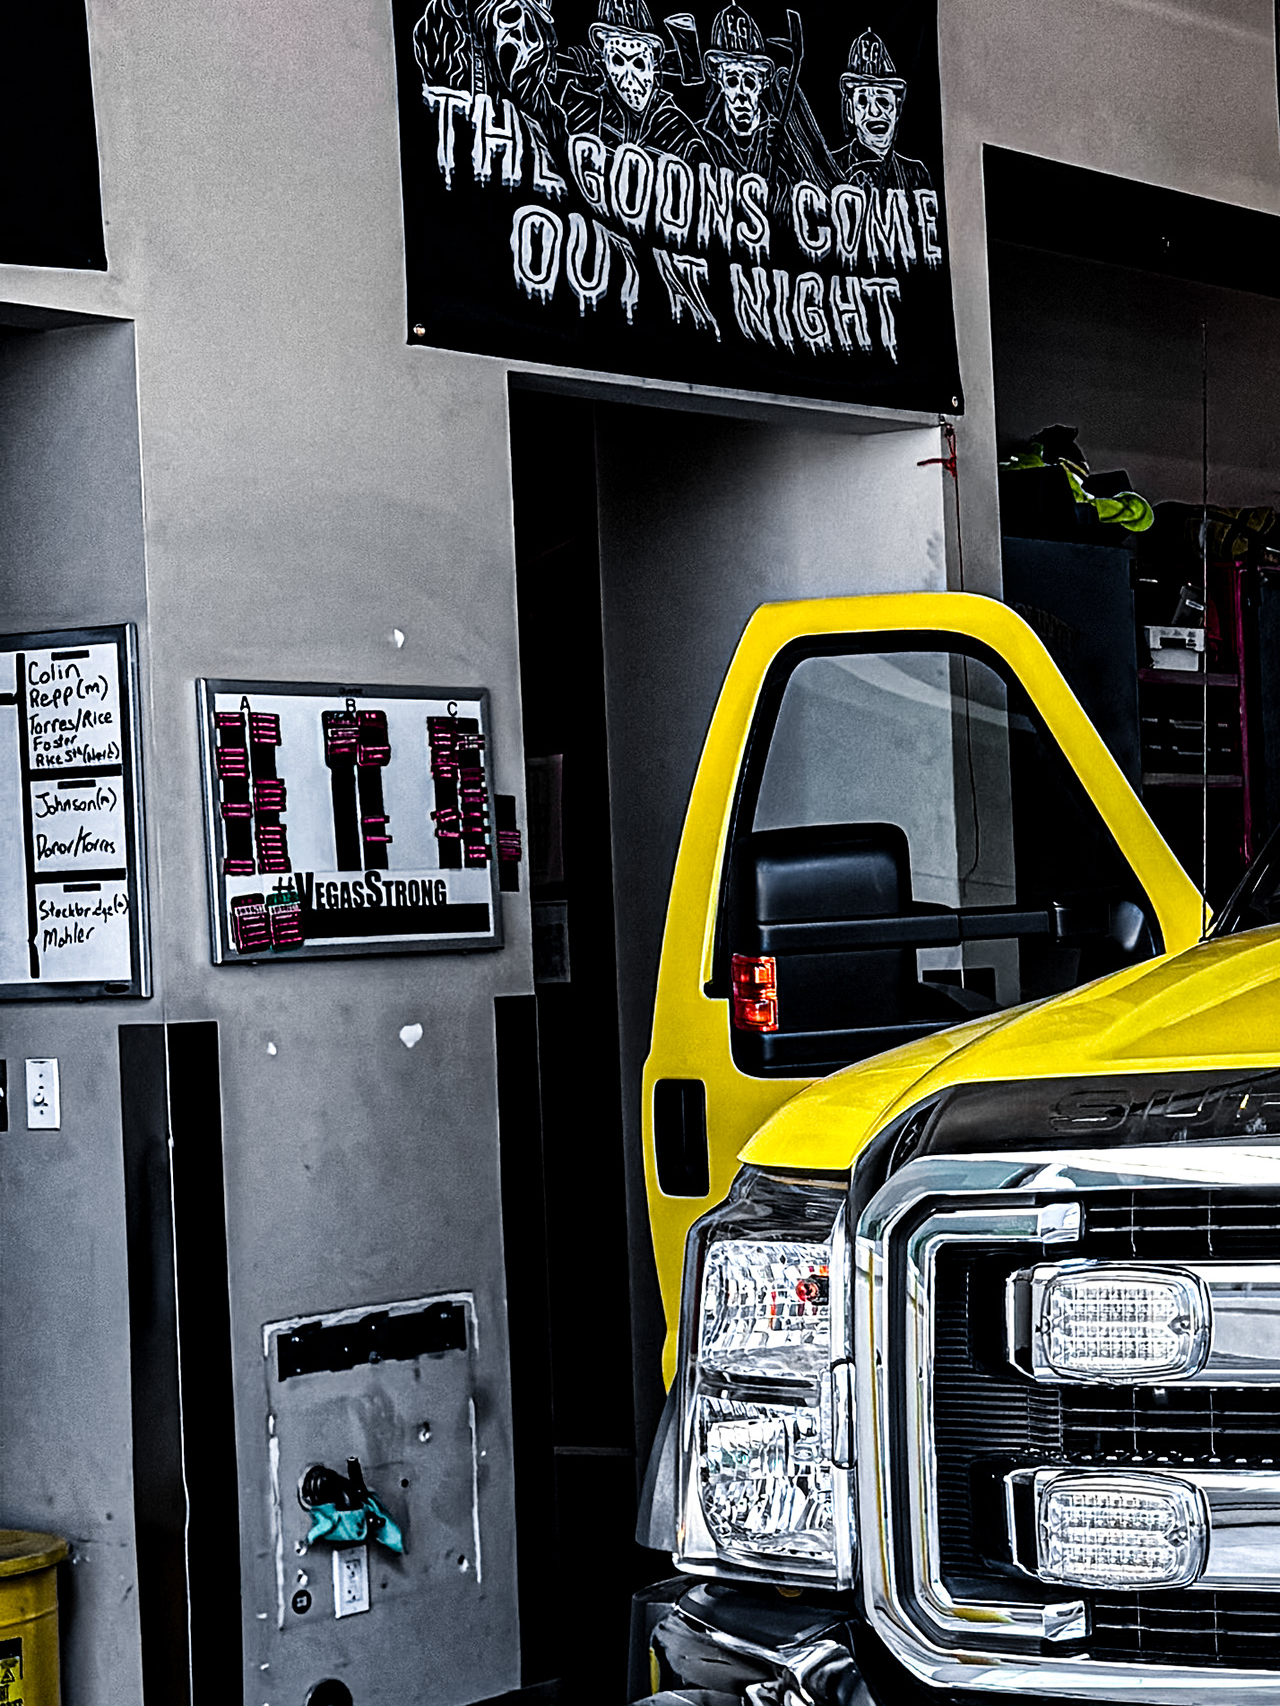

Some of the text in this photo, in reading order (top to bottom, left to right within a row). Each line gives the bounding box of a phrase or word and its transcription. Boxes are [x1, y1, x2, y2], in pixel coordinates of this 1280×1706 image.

[567, 132, 770, 263] GOONS
[791, 179, 942, 271] COME
[730, 262, 903, 363] NIGHT
[28, 661, 80, 686] Colin
[240, 695, 251, 712] A
[345, 698, 357, 713] B
[446, 701, 459, 718] C
